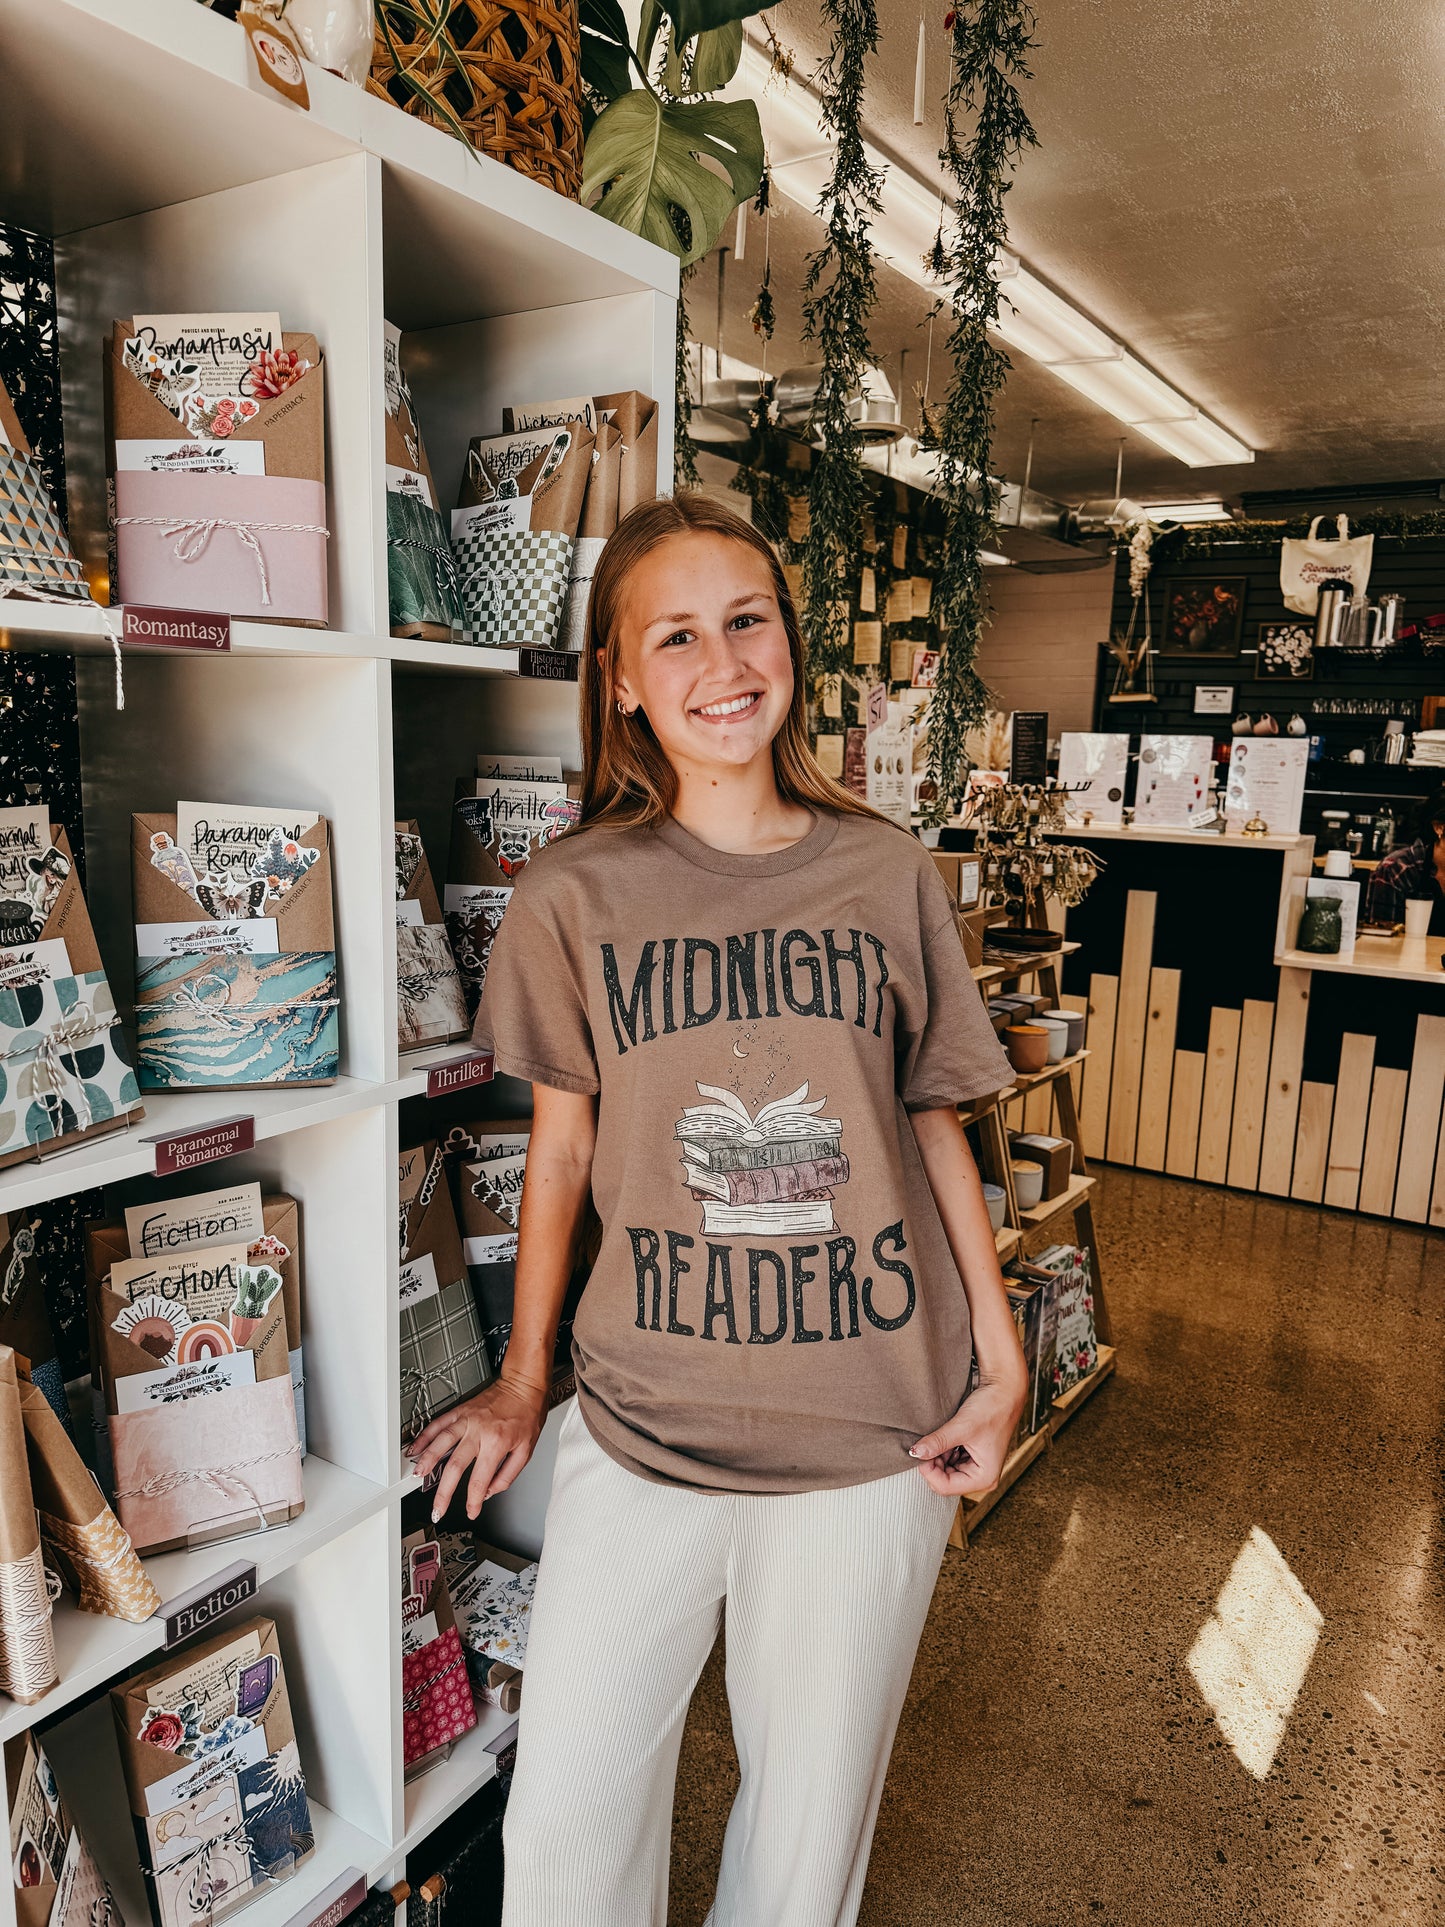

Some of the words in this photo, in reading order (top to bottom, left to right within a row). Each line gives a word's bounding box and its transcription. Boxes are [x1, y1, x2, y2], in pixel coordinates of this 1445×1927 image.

[136, 327, 272, 396] Romantasy
[264, 394, 307, 428] PAPERBACK
[126, 614, 229, 647] Romantasy
[530, 650, 567, 666] Historical
[491, 788, 547, 821] Thrille
[194, 820, 300, 854] Paranoral
[206, 845, 256, 875] Roma
[57, 887, 78, 928] PAPERBACK
[279, 875, 313, 916] PAPERBACK
[600, 928, 890, 1055] MIDNIGHT
[435, 1061, 487, 1089] Thriller
[167, 1125, 239, 1157] Paranormal
[176, 1143, 233, 1168] Romance
[140, 1213, 238, 1258] Fiction
[273, 1247, 286, 1256] to
[125, 1264, 238, 1302] Fiction
[625, 1218, 917, 1345] READERS
[254, 1315, 283, 1360] PAPERBACK
[550, 1376, 575, 1403] Myst
[175, 1579, 251, 1638] Fiction
[182, 1658, 239, 1711] Sci-F
[324, 1909, 343, 1927] ovel
